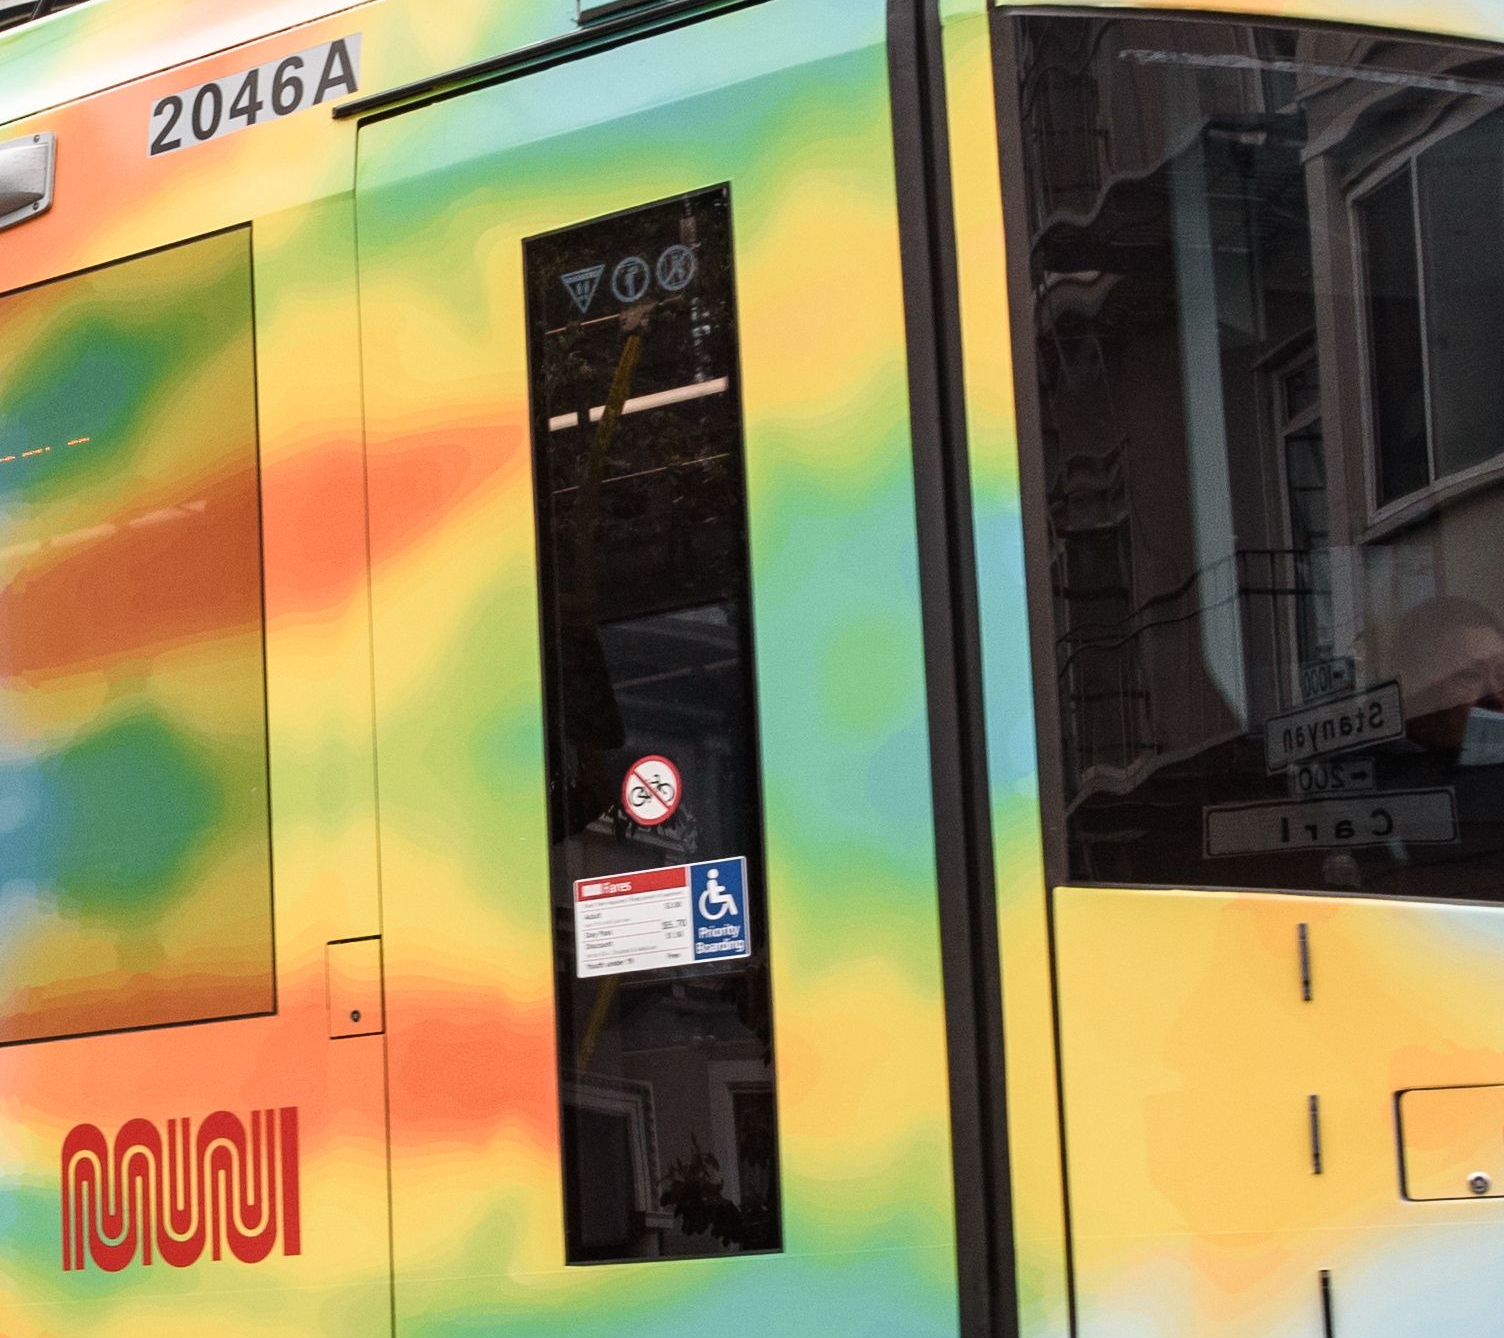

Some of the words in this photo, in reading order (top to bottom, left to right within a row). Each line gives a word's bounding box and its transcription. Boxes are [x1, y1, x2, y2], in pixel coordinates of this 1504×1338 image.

[151, 37, 361, 156] 2046A
[698, 924, 741, 938] Priority
[695, 938, 745, 953] Boarding
